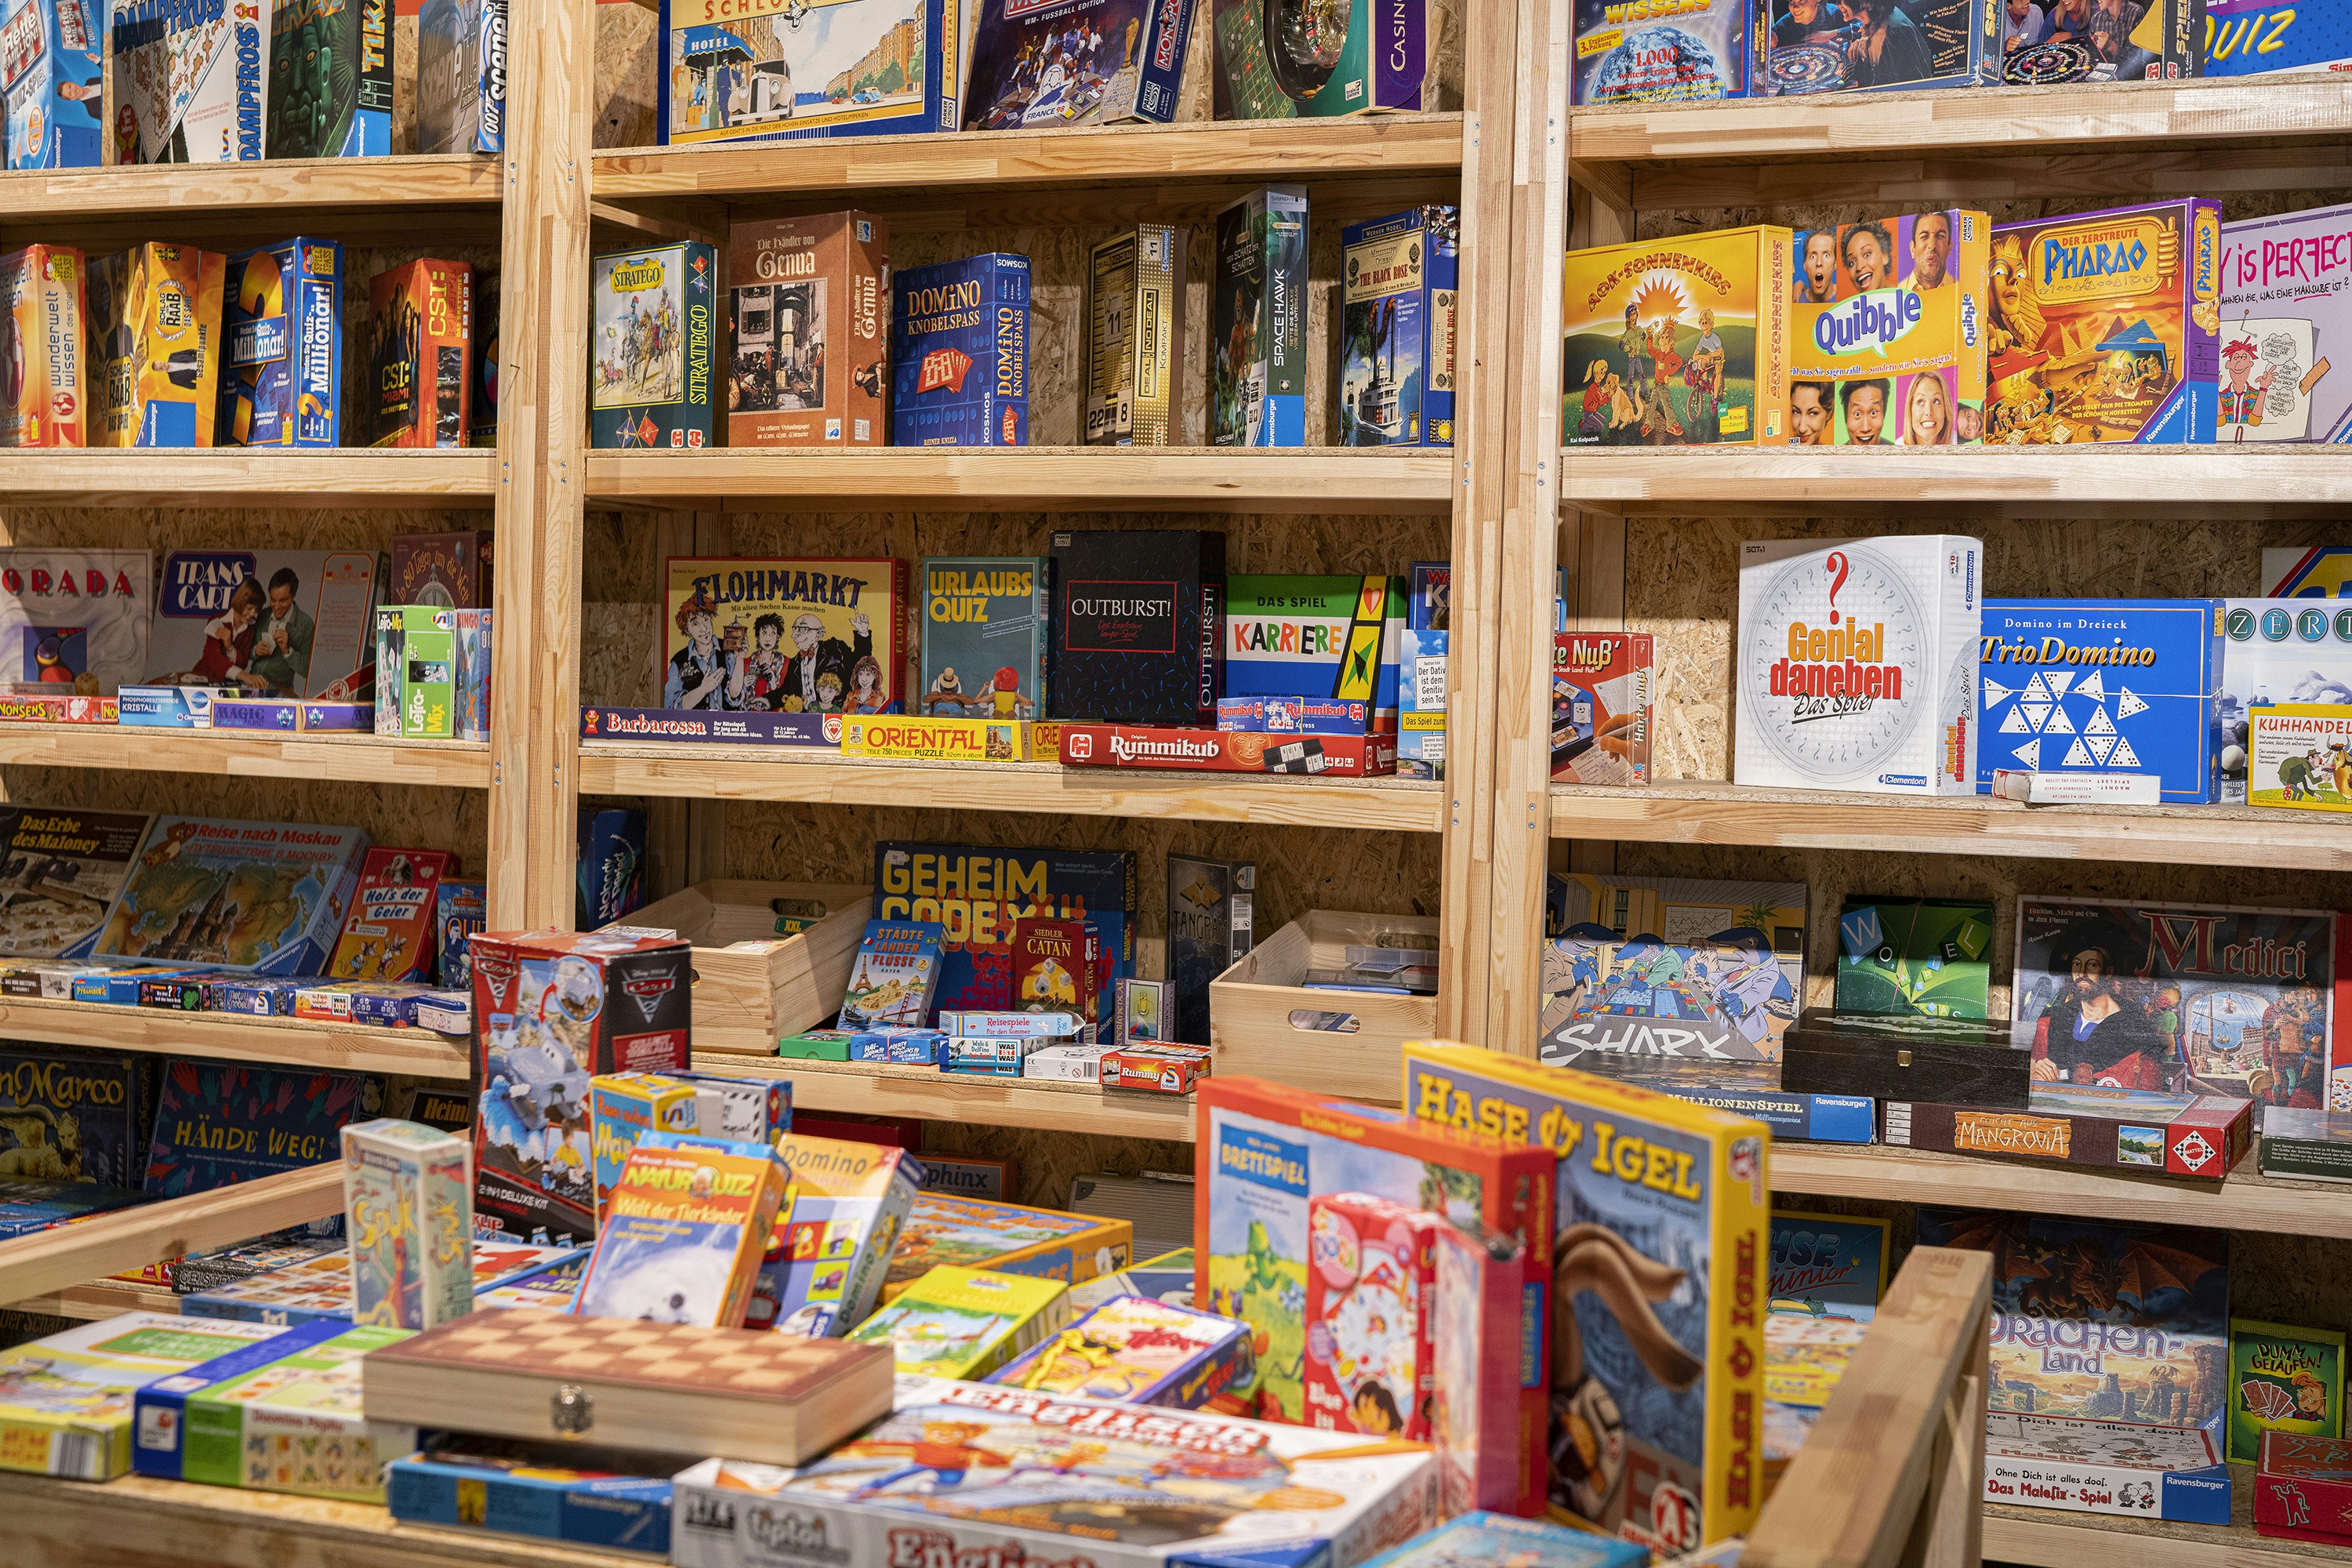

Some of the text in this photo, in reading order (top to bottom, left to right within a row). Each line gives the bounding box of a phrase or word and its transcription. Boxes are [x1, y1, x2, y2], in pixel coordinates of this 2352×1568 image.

[691, 36, 729, 52] HOTEL
[1588, 33, 1621, 45] Ergänzungs-
[1589, 41, 1612, 50] Packung
[1635, 46, 1678, 67] 1.000
[1143, 82, 1153, 111] PARKER
[1026, 105, 1065, 121] FRANCE 98
[757, 239, 771, 250] Die
[802, 236, 815, 246] von
[2062, 228, 2139, 247] DER ZERSTREUTE
[756, 250, 816, 279] Genua
[996, 259, 1028, 269] KOSMOS
[2044, 239, 2147, 286] PHARAO
[614, 267, 660, 288] STRATEGO
[1359, 263, 1409, 287] THE BLACK ROSE
[1587, 252, 1732, 314] AOK-SONNENKIDS
[429, 271, 447, 336] CSI:
[2221, 295, 2245, 305] AHNEN
[2259, 290, 2276, 301] WAS
[2294, 282, 2331, 297] MANSUBE
[166, 292, 181, 326] RAAB
[861, 276, 877, 339] Genua
[1274, 268, 1285, 367] SPACE HAWK
[908, 310, 980, 336] KNOBELSPASS
[1815, 289, 1921, 355] Quibble
[47, 290, 60, 387] wunderwelt
[63, 333, 75, 387] wissen
[690, 304, 708, 405] STRATEGO
[1014, 310, 1023, 397] KNOBELSPASS
[382, 360, 409, 391] CSI:
[1089, 407, 1104, 429] 22
[1120, 402, 1127, 423] 8
[2145, 394, 2186, 442] Ravensburger
[176, 561, 252, 585] TRANS-
[692, 569, 869, 609] FLOHMARKT
[929, 572, 1032, 597] URLAUBS
[178, 586, 235, 610] CART
[1072, 598, 1171, 617] OUTBURST!
[1257, 597, 1327, 608] DAS SPIEL
[458, 612, 479, 629] BINGO
[802, 605, 826, 614] machen
[929, 597, 988, 624] QUIZ
[2005, 619, 2052, 629] Domino
[2078, 619, 2127, 629] Dreieck
[1201, 588, 1214, 706] OUTBURST!
[1234, 622, 1342, 655] KARRIERE
[1788, 616, 1883, 662] Genial
[1980, 636, 2156, 668] TrioDomino
[1431, 666, 1446, 675] Dativ
[1769, 658, 1901, 699] daneben
[1422, 686, 1443, 695] Genitiv
[1436, 695, 1446, 703] Tod
[122, 704, 162, 713] KRISTALLE
[1218, 705, 1254, 720] Rummikub
[1286, 702, 1347, 719] Rummikub
[1793, 688, 1880, 719] Das Spiel
[426, 704, 443, 732] Mix
[607, 713, 706, 736] Barbarossa
[1418, 717, 1432, 728] Spiel
[2259, 718, 2352, 735] KUHHANDEL
[867, 726, 983, 750] ORIENTAL
[1109, 735, 1219, 760] Rummikub
[914, 749, 943, 757] PUZZLE
[1886, 776, 1926, 786] Clementoni
[19, 815, 81, 833] Das Erbe
[198, 824, 343, 846] Reise nach Moskau
[12, 832, 36, 847] des
[38, 834, 100, 855] Maloney
[882, 852, 1047, 903] GEHEIM
[366, 889, 423, 902] Hol's der
[374, 906, 408, 919] Geier
[785, 920, 802, 931] XXL
[877, 927, 924, 940] STÄDTE
[1034, 927, 1063, 938] SIEDLER
[1173, 910, 1228, 942] TANGRAM
[874, 942, 920, 954] LÄNDER
[1026, 938, 1072, 958] CATAN
[2135, 911, 2307, 982] Medici
[872, 954, 916, 967] FLÜSSE
[987, 1018, 1030, 1028] Reisespiele
[13, 1061, 125, 1109] Marco
[1121, 1067, 1160, 1083] Rummy
[1816, 1098, 1867, 1108] Ravensburger
[267, 1128, 325, 1160] WEG!
[1416, 1073, 1528, 1143] HASE
[1592, 1122, 1700, 1200] IGEL
[784, 1145, 866, 1174] Domino
[2185, 1146, 2204, 1155] MATTEL
[1221, 1143, 1307, 1185] BRETTSPIEL
[2040, 1348, 2106, 1376] land
[2251, 1352, 2324, 1374] GELAUFEN!
[2257, 1344, 2306, 1360] DUMM
[1995, 1468, 2107, 1486] Ohne Dich ist alles doof.
[2167, 1477, 2224, 1489] Ravensburger
